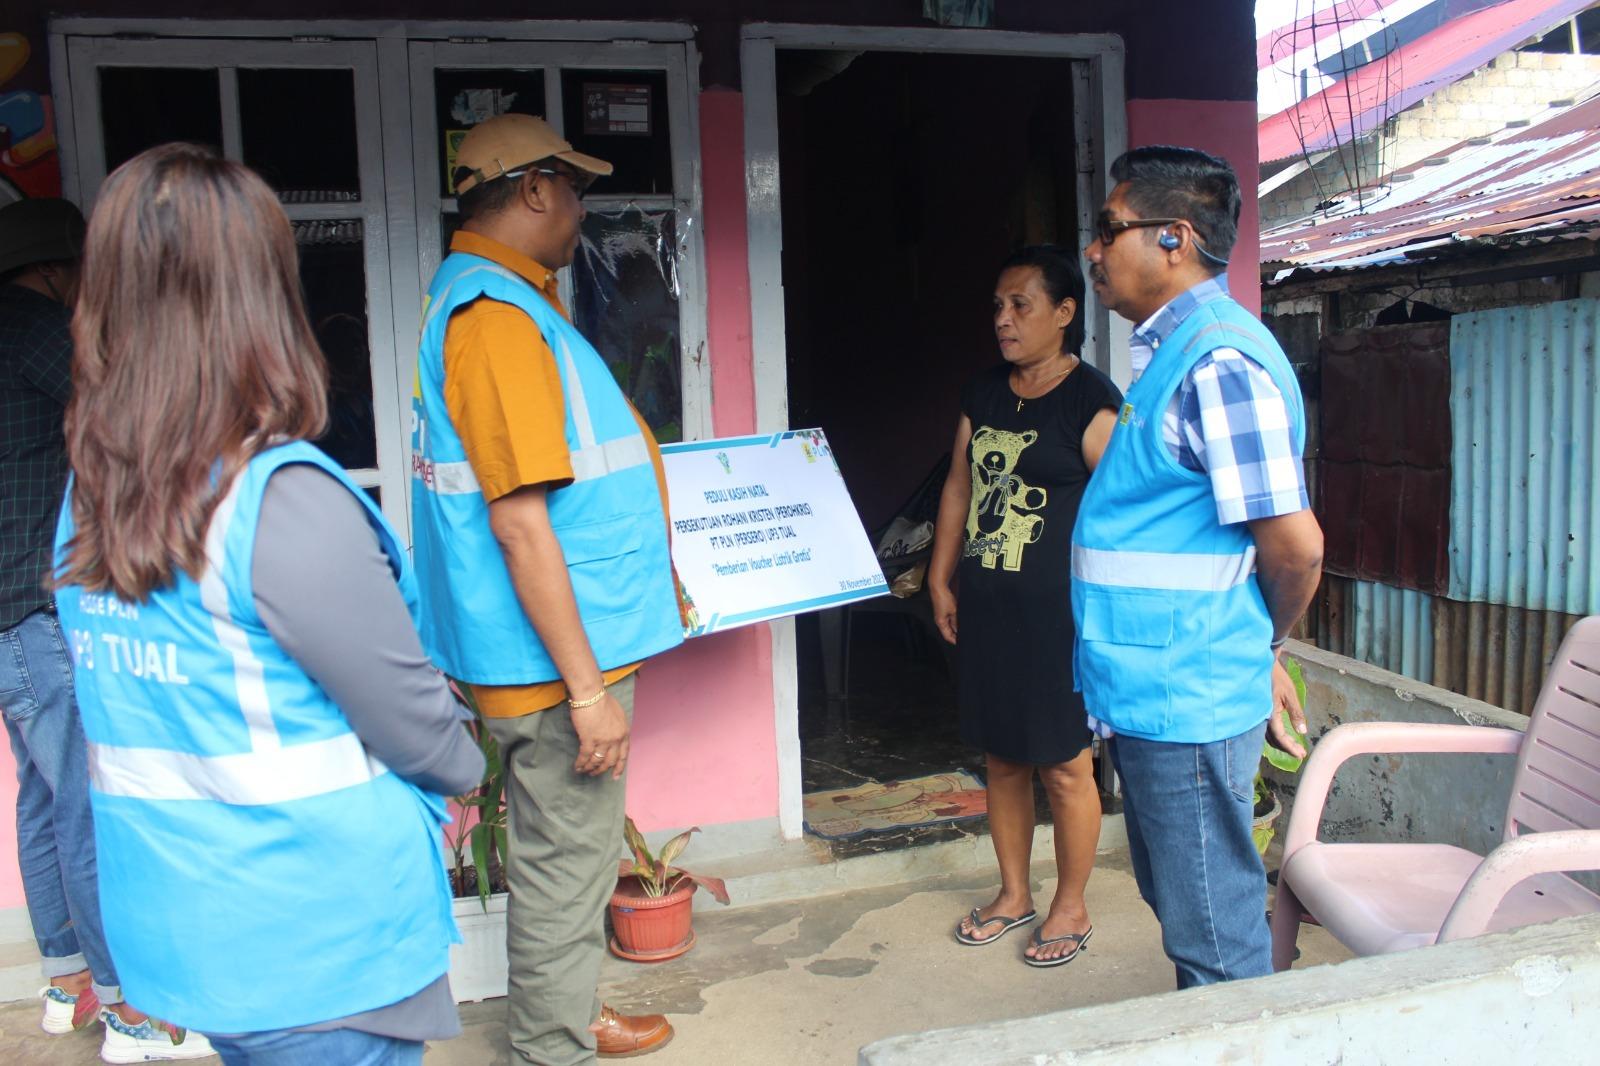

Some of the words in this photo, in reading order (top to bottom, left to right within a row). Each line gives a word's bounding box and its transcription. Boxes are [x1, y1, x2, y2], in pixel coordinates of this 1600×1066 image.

[704, 489, 729, 504] PEDULI
[728, 486, 748, 501] KASIH
[748, 484, 769, 498] NATAL
[674, 515, 722, 534] PERSEKUTUAN
[722, 511, 749, 527] ROHANI
[749, 507, 775, 523] KRISTEN
[774, 502, 813, 521] (PEROHKRIS)
[709, 536, 720, 550] PT
[718, 533, 734, 549] PLN
[733, 529, 768, 548] (PERSERO)
[766, 527, 780, 541] UP3
[779, 525, 797, 539] TUAL
[748, 556, 773, 571] Voucher
[772, 550, 792, 566] Listrik
[846, 576, 872, 589] November
[102, 633, 189, 684] TUAL
